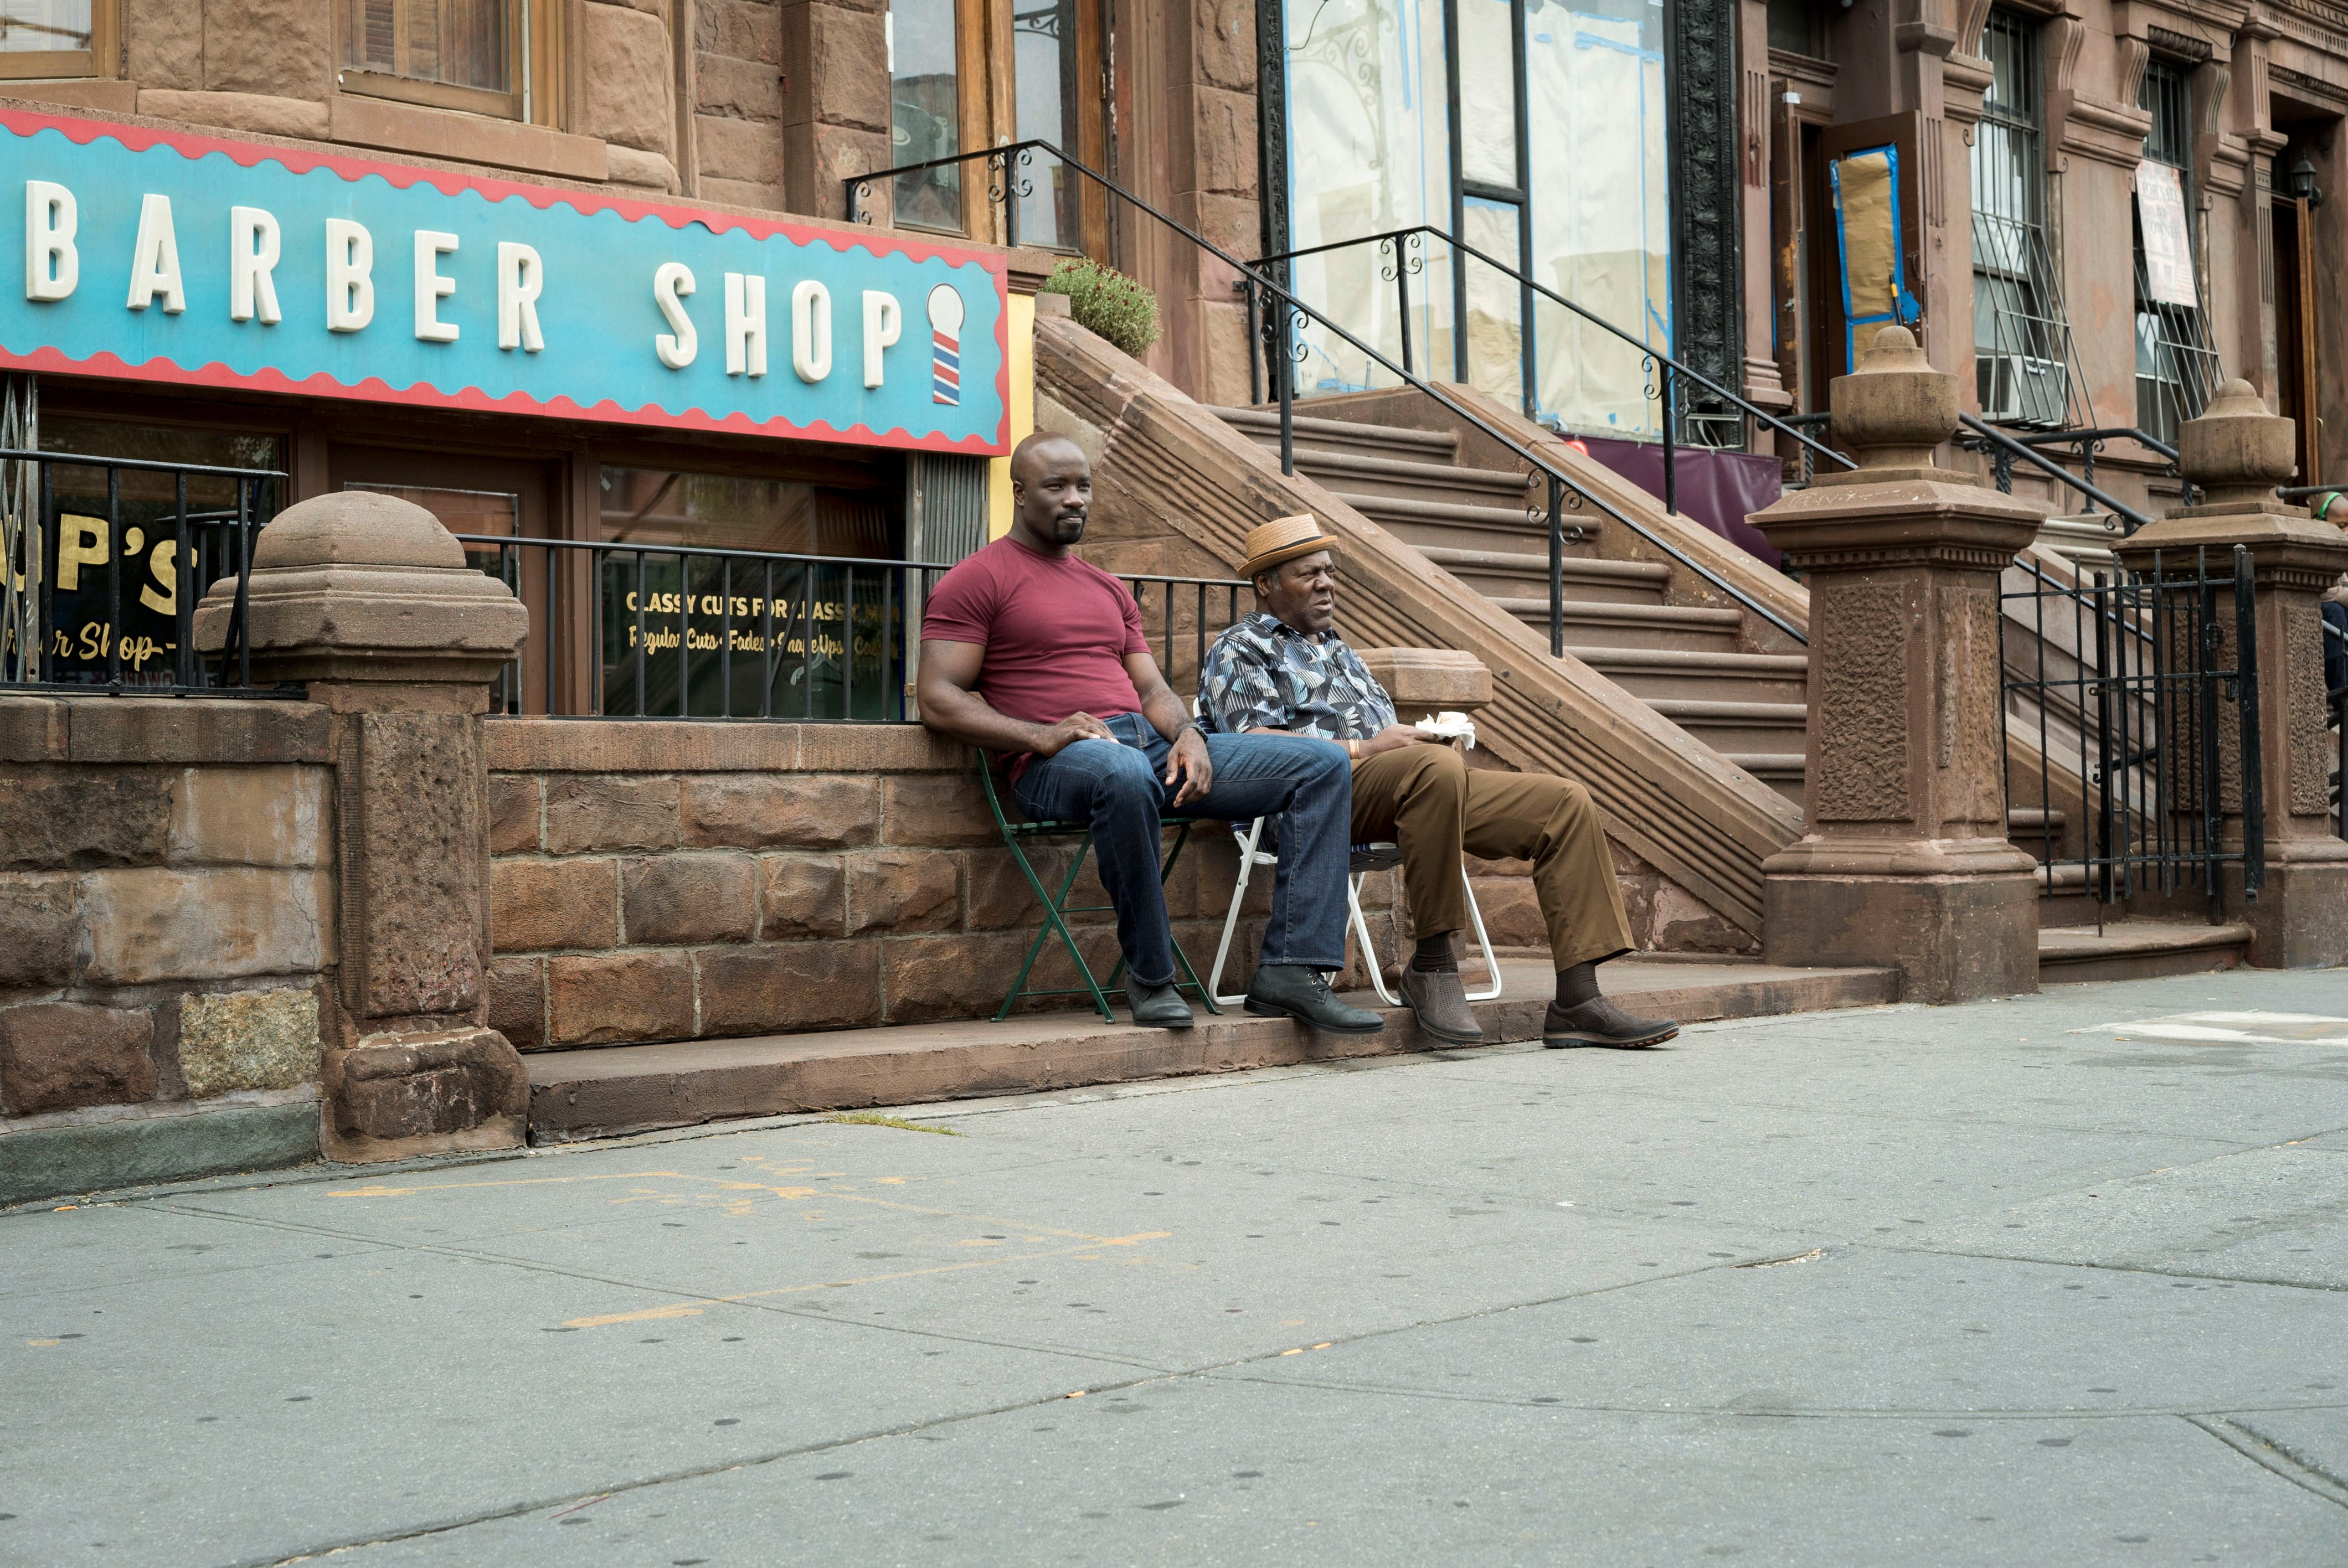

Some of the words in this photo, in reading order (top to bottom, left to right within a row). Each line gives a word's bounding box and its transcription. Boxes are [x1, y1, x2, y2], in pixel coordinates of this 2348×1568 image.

[2142, 182, 2158, 197] FOR
[2155, 204, 2166, 218] BY
[2149, 221, 2181, 240] OWNER
[25, 180, 544, 353] BARBER
[653, 262, 902, 389] SHOP
[701, 595, 748, 616] CUTS
[791, 601, 860, 621] ASSC
[79, 621, 163, 671] Shop
[687, 628, 719, 650] Cuts
[729, 630, 764, 652] Fades
